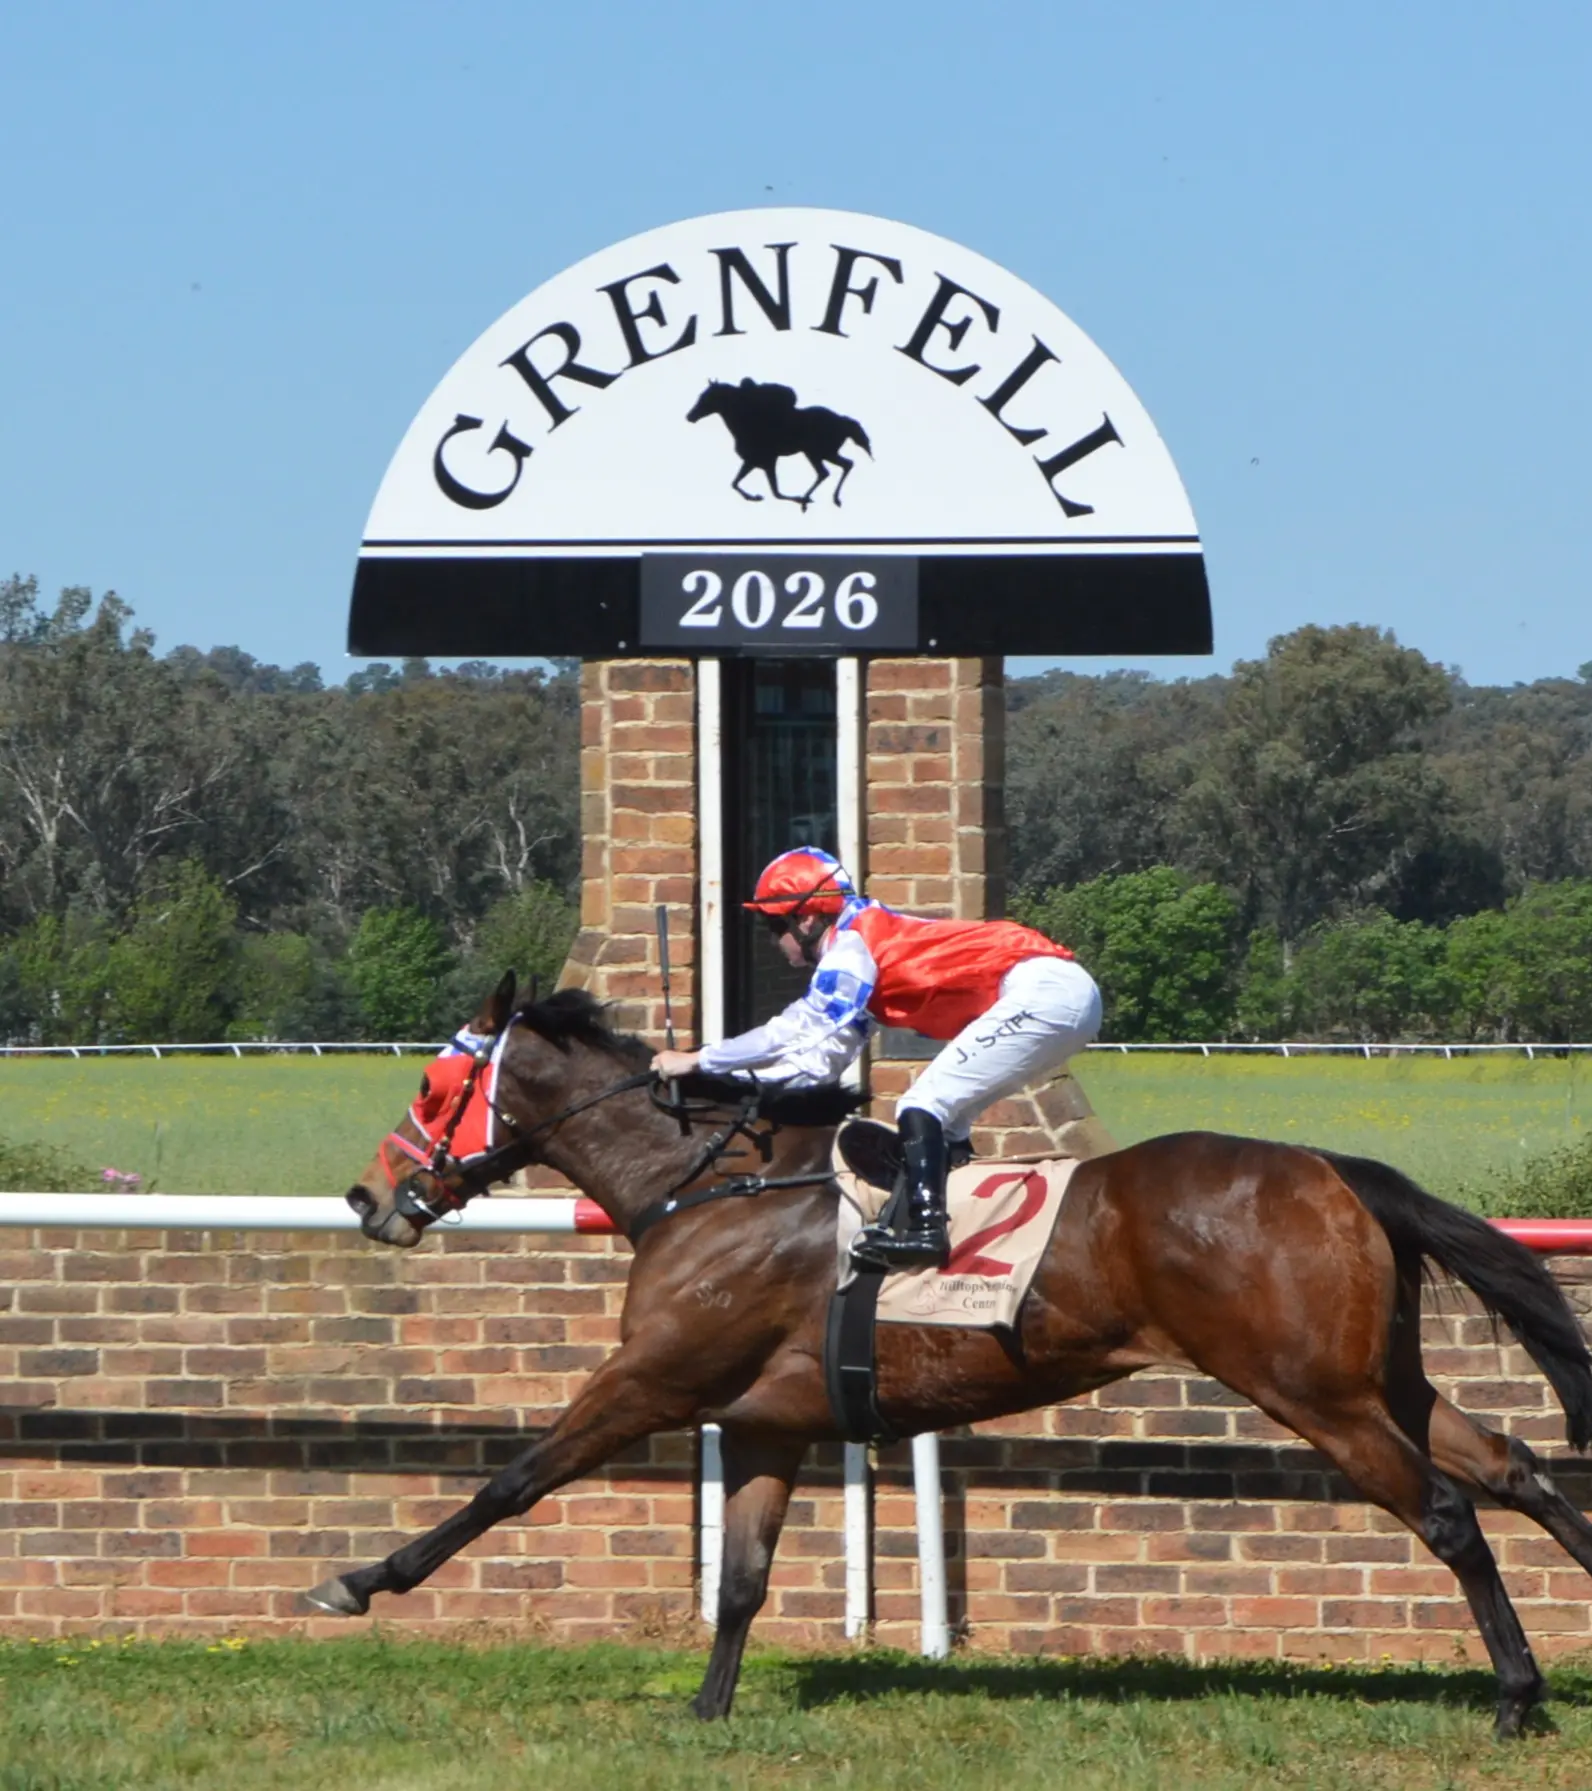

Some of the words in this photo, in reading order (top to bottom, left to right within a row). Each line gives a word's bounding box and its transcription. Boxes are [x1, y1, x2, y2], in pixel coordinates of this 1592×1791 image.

[432, 241, 1126, 519] GRENFELL
[678, 568, 880, 631] 2026
[936, 1169, 1048, 1278] 2
